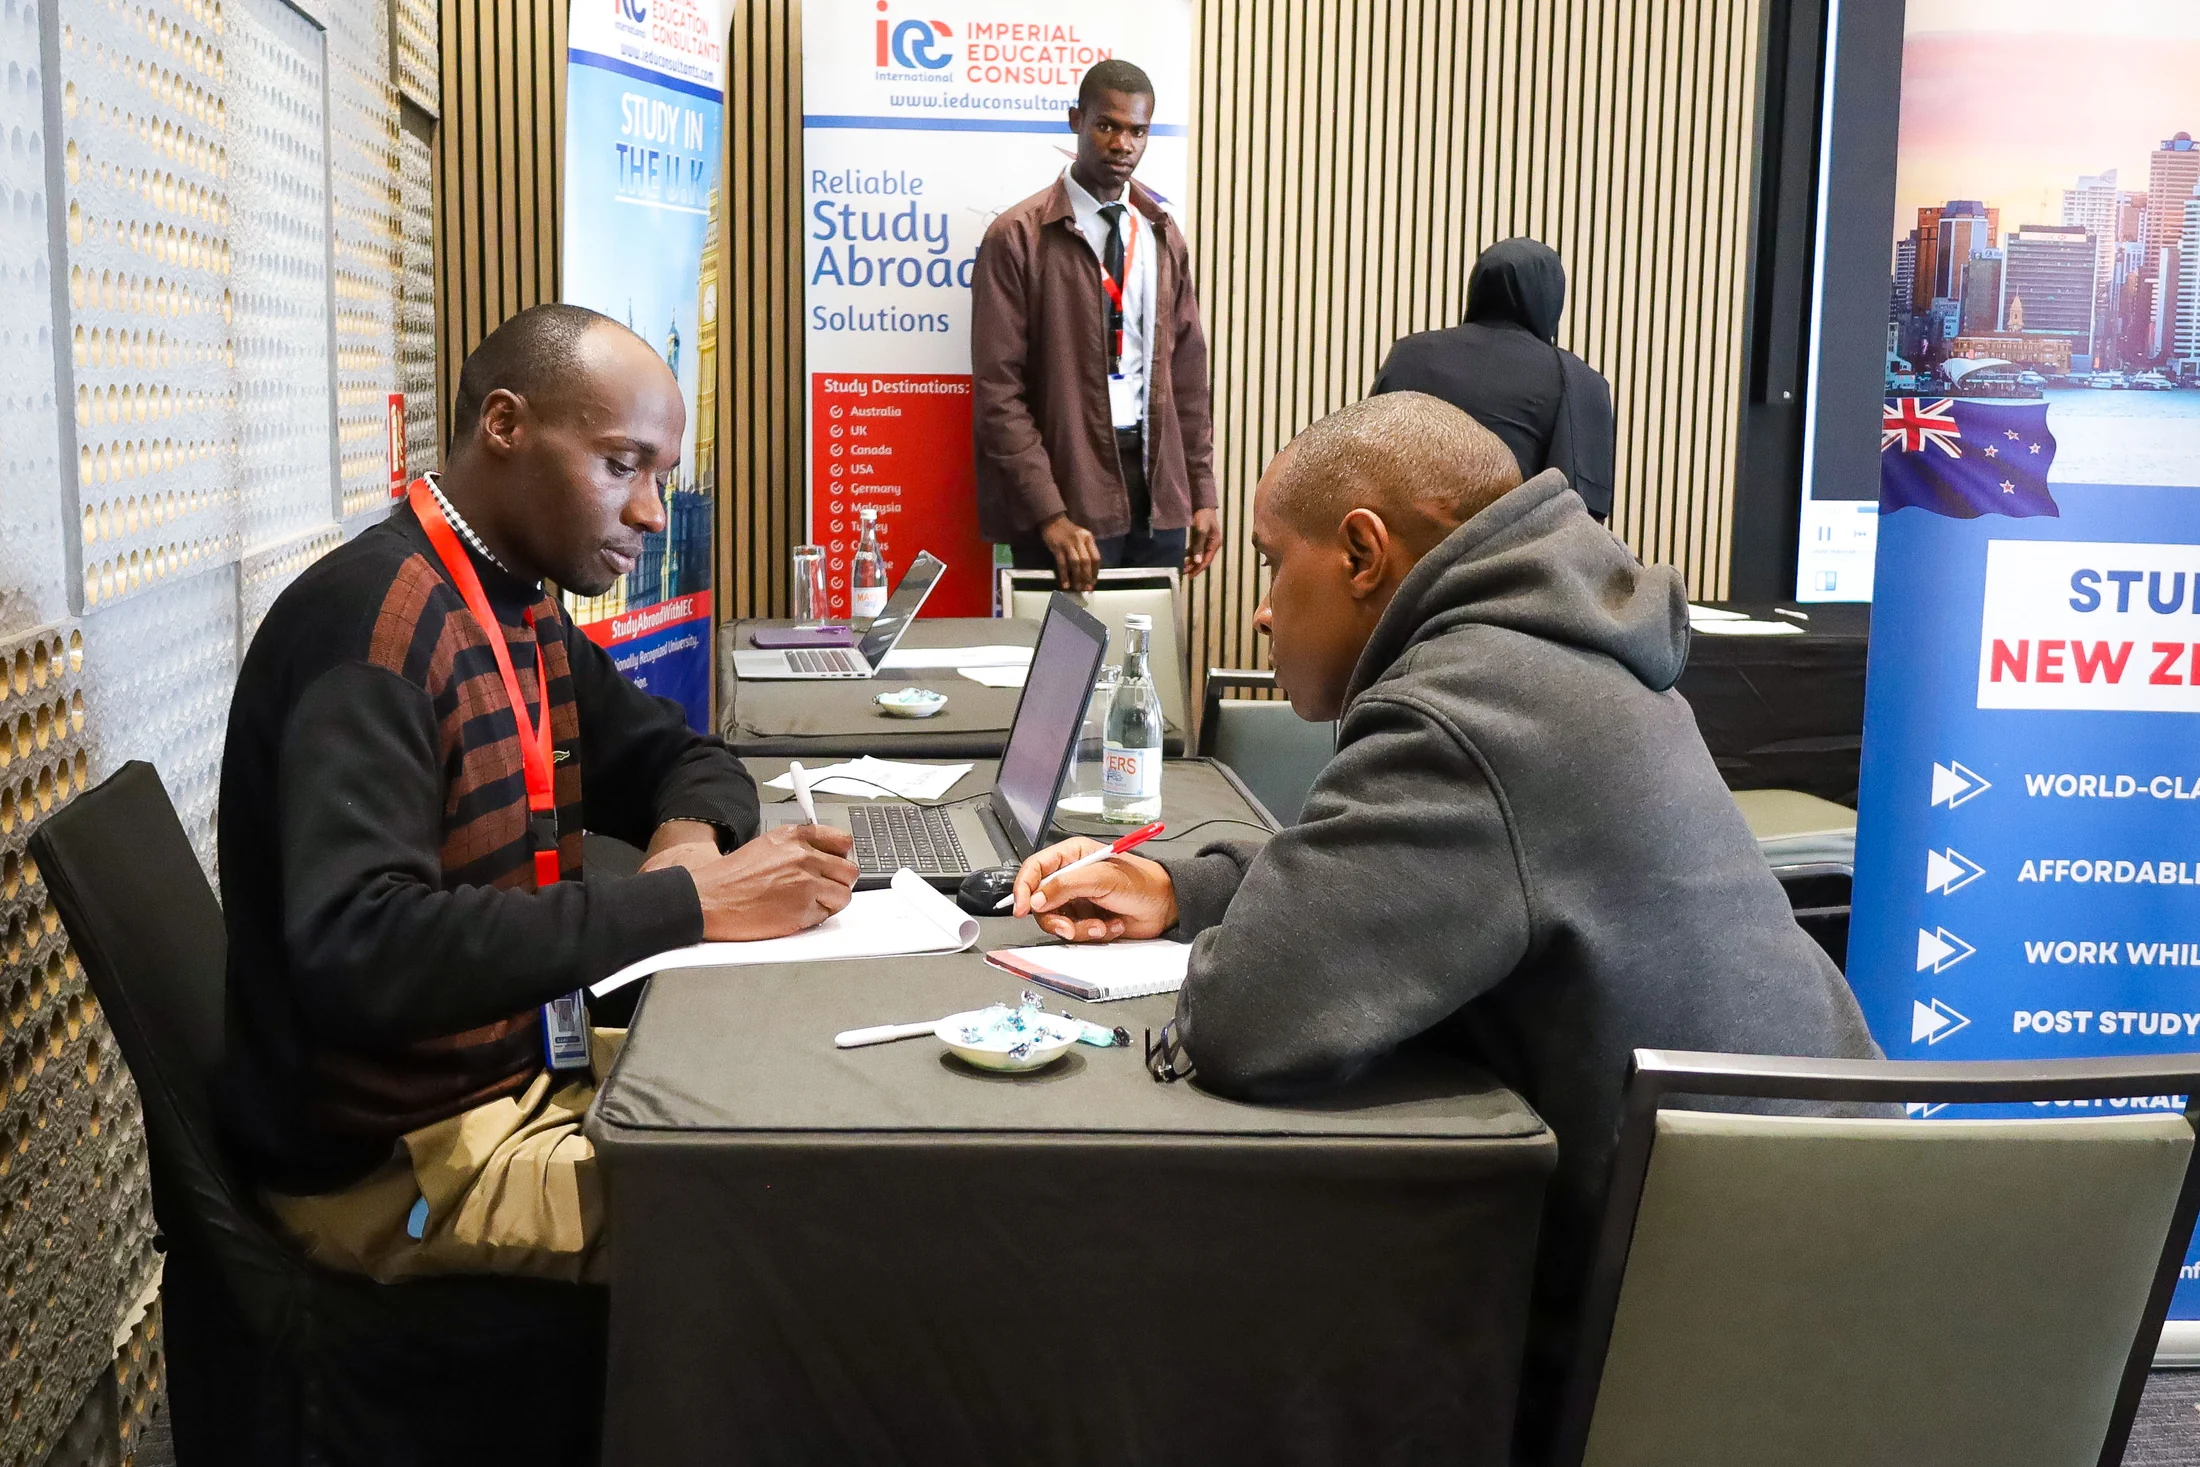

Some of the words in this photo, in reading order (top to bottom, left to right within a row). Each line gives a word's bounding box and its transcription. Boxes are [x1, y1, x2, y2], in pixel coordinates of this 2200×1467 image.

[653, 0, 709, 37] EDUCATION
[652, 23, 720, 63] CONSULTANTS
[967, 22, 1081, 42] IMPERIAL
[967, 44, 1112, 65] EDUCATION
[876, 71, 953, 83] International
[967, 65, 1083, 86] CONSULT
[621, 91, 680, 145] STUDY
[683, 108, 703, 153] IN
[616, 141, 660, 198] THE
[812, 169, 923, 195] Reliable
[812, 200, 950, 255] Study
[812, 305, 950, 332] Solutions
[824, 379, 868, 397] Study
[872, 379, 970, 394] Destinations:
[850, 406, 902, 417] Australia
[850, 425, 868, 436] UK
[850, 444, 892, 455] Canada
[850, 464, 874, 475] USA
[850, 482, 902, 496] Germany
[851, 520, 889, 535] Tuey
[1990, 639, 2134, 684] NEW
[2025, 773, 2200, 800] WORLD-CL
[2024, 941, 2119, 965] WORK
[2013, 1011, 2093, 1034] POST
[2099, 1011, 2200, 1036] STUDY
